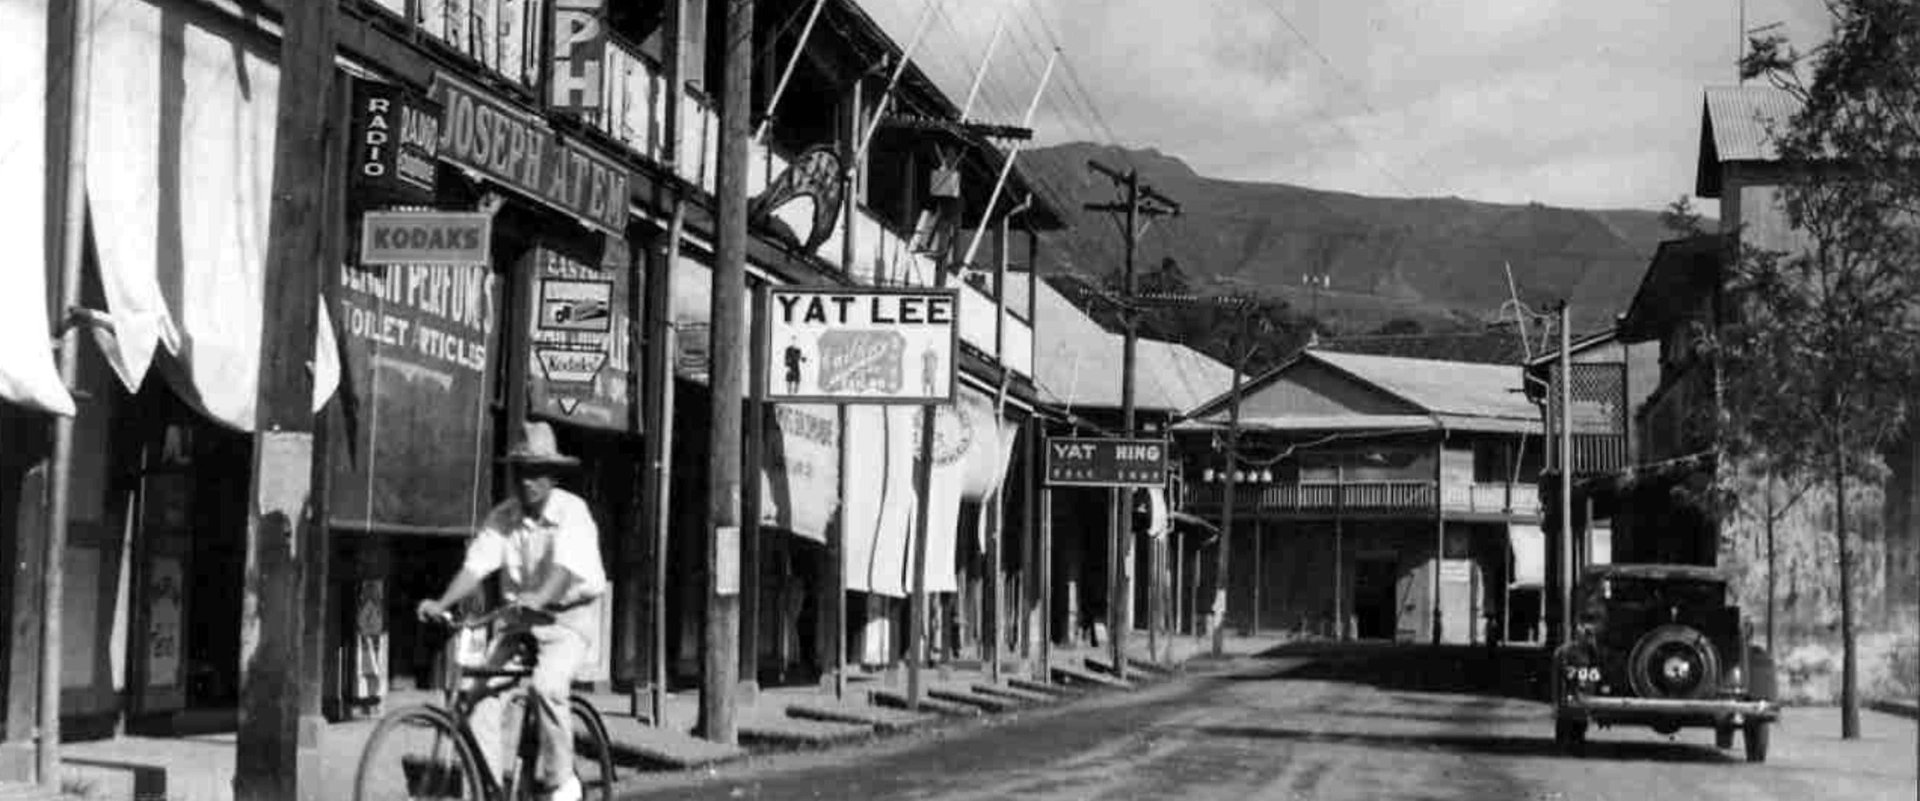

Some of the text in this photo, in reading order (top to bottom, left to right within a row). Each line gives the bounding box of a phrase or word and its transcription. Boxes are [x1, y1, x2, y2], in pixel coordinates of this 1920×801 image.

[552, 0, 600, 107] PH
[364, 98, 390, 176] RADIO
[440, 86, 545, 190] JOSEPH
[373, 226, 481, 249] KODAKS
[777, 295, 953, 324] YAT LEE
[1053, 443, 1097, 460] YAT
